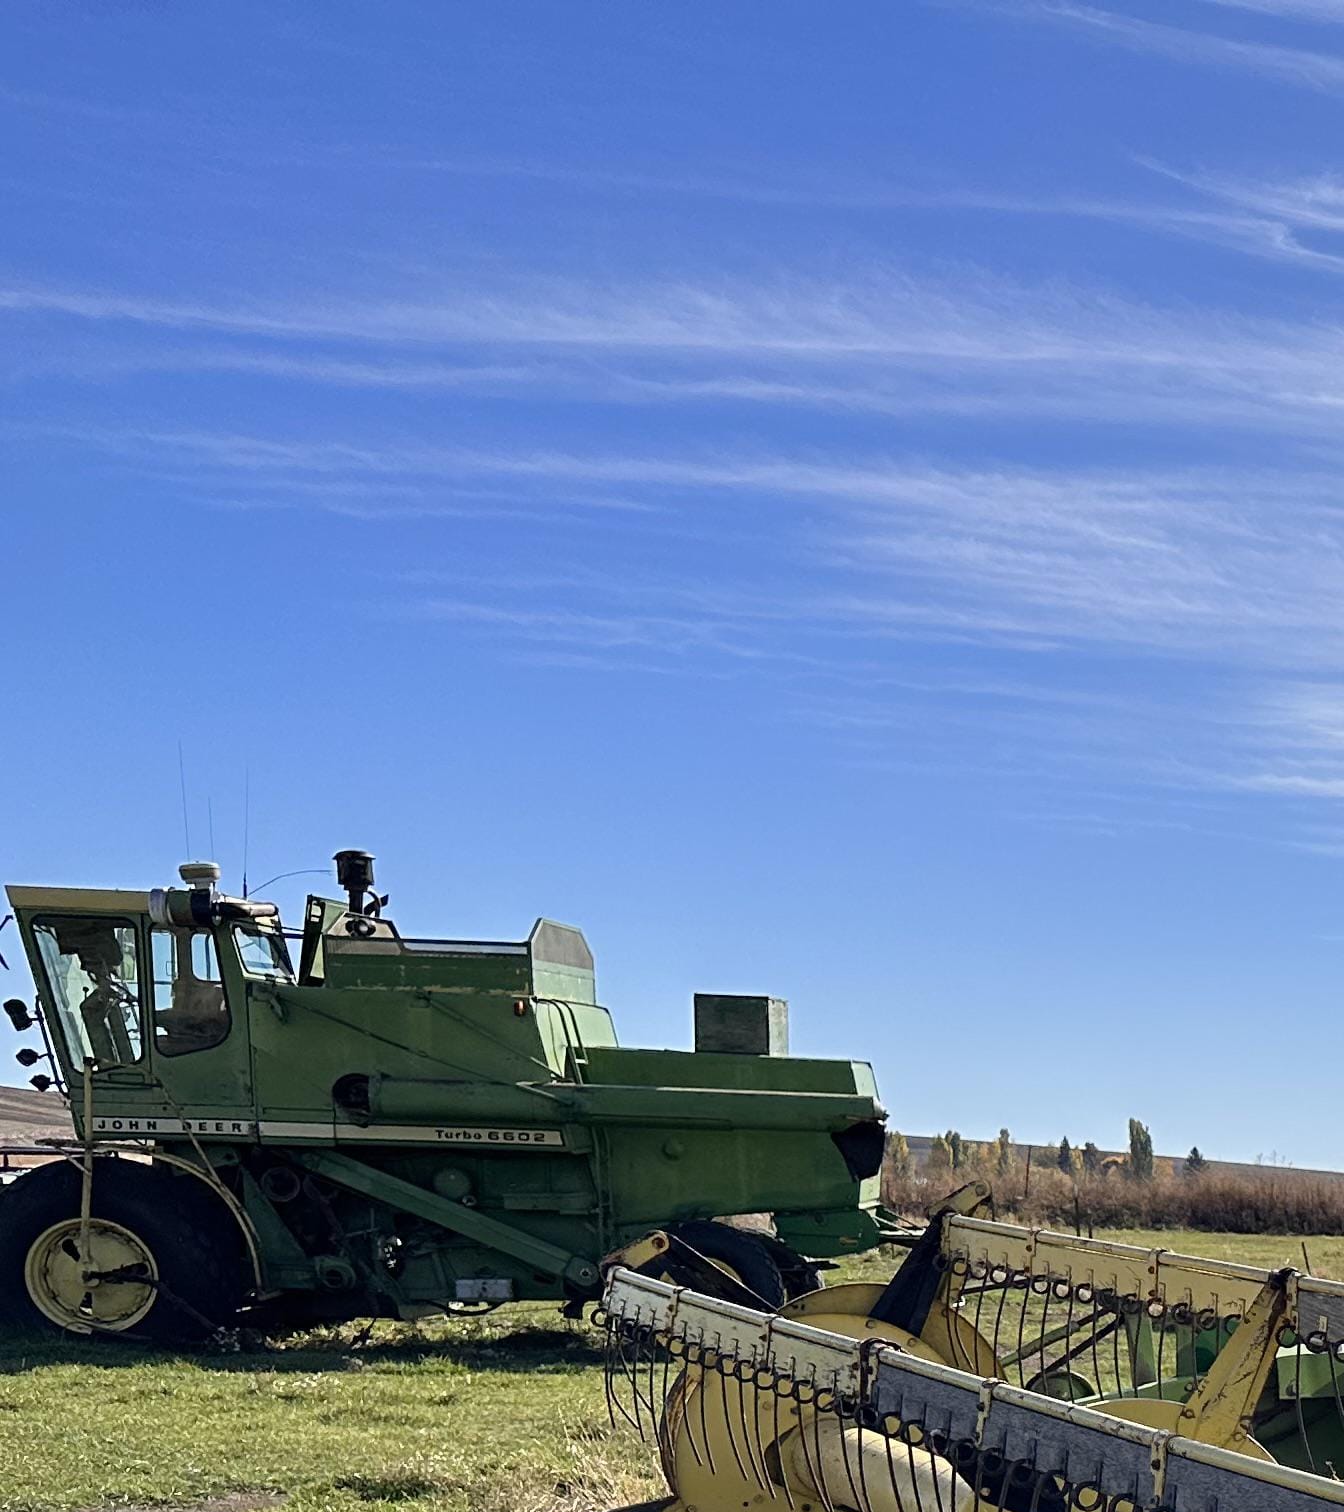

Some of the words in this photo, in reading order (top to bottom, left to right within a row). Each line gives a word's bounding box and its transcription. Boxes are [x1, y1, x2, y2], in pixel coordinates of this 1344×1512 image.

[98, 1119, 157, 1131] JOHN
[435, 1129, 483, 1140] Turbo
[487, 1131, 545, 1143] 6602
